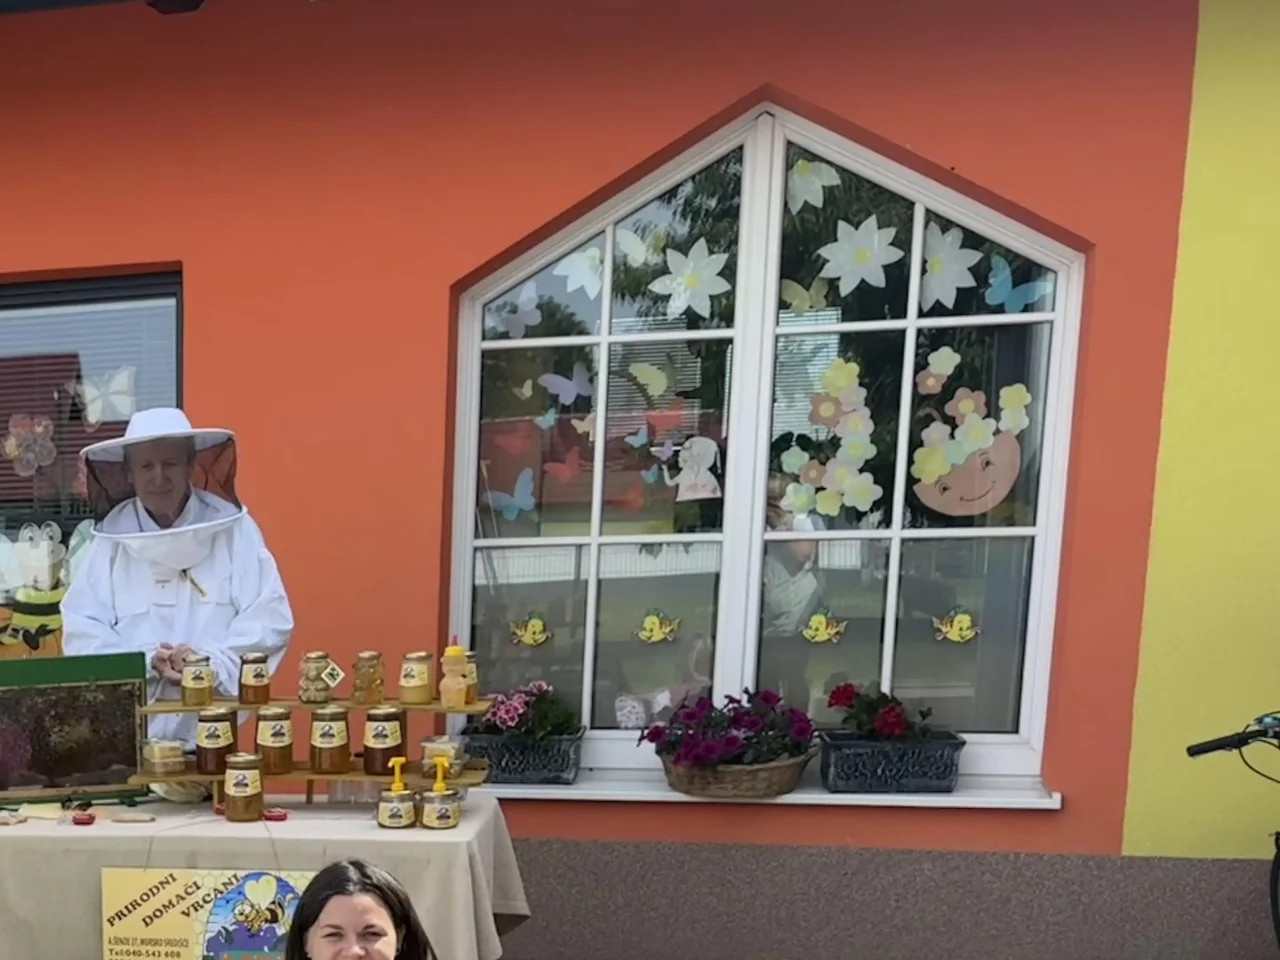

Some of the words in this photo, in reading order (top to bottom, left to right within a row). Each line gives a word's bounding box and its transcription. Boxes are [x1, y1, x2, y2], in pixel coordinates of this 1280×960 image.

[106, 873, 178, 927] PRIRODNI
[141, 881, 201, 928] DOMAČI
[180, 873, 242, 919] VRCANI
